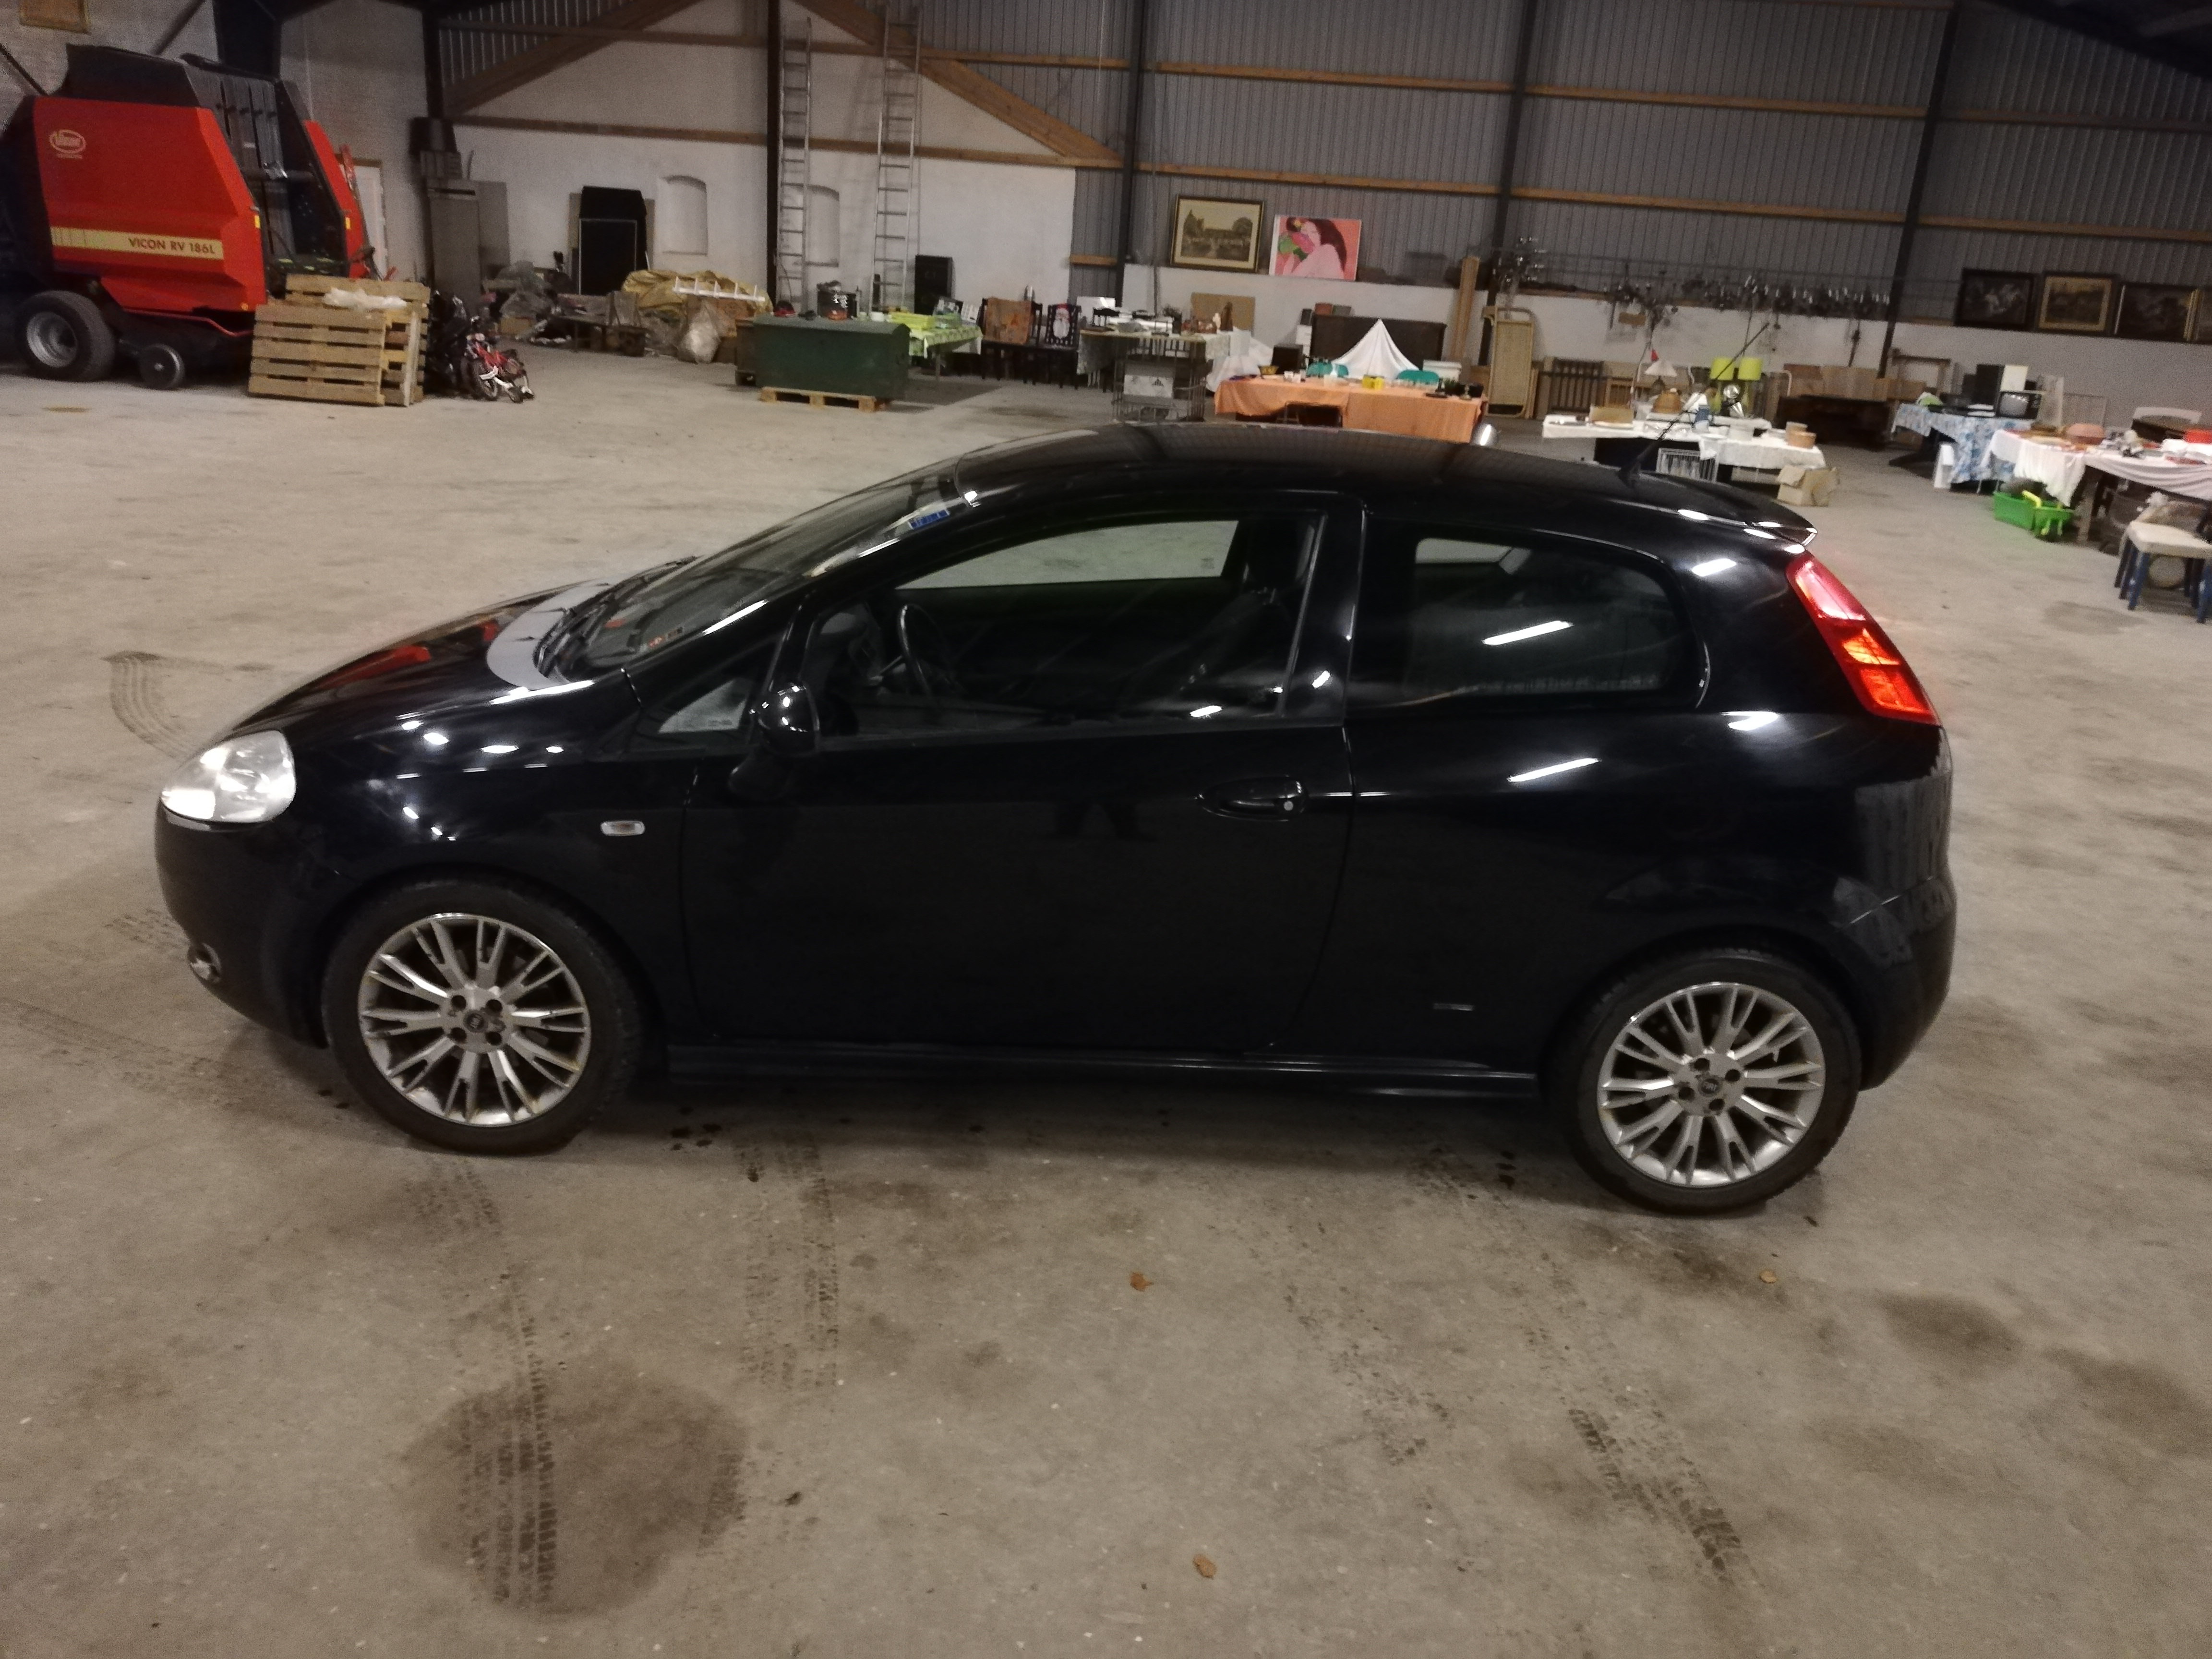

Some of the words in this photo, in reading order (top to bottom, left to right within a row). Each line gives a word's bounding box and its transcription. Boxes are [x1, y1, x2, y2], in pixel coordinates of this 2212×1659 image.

[128, 238, 166, 250] VICON
[170, 240, 185, 251] RV
[189, 242, 216, 253] 186L
